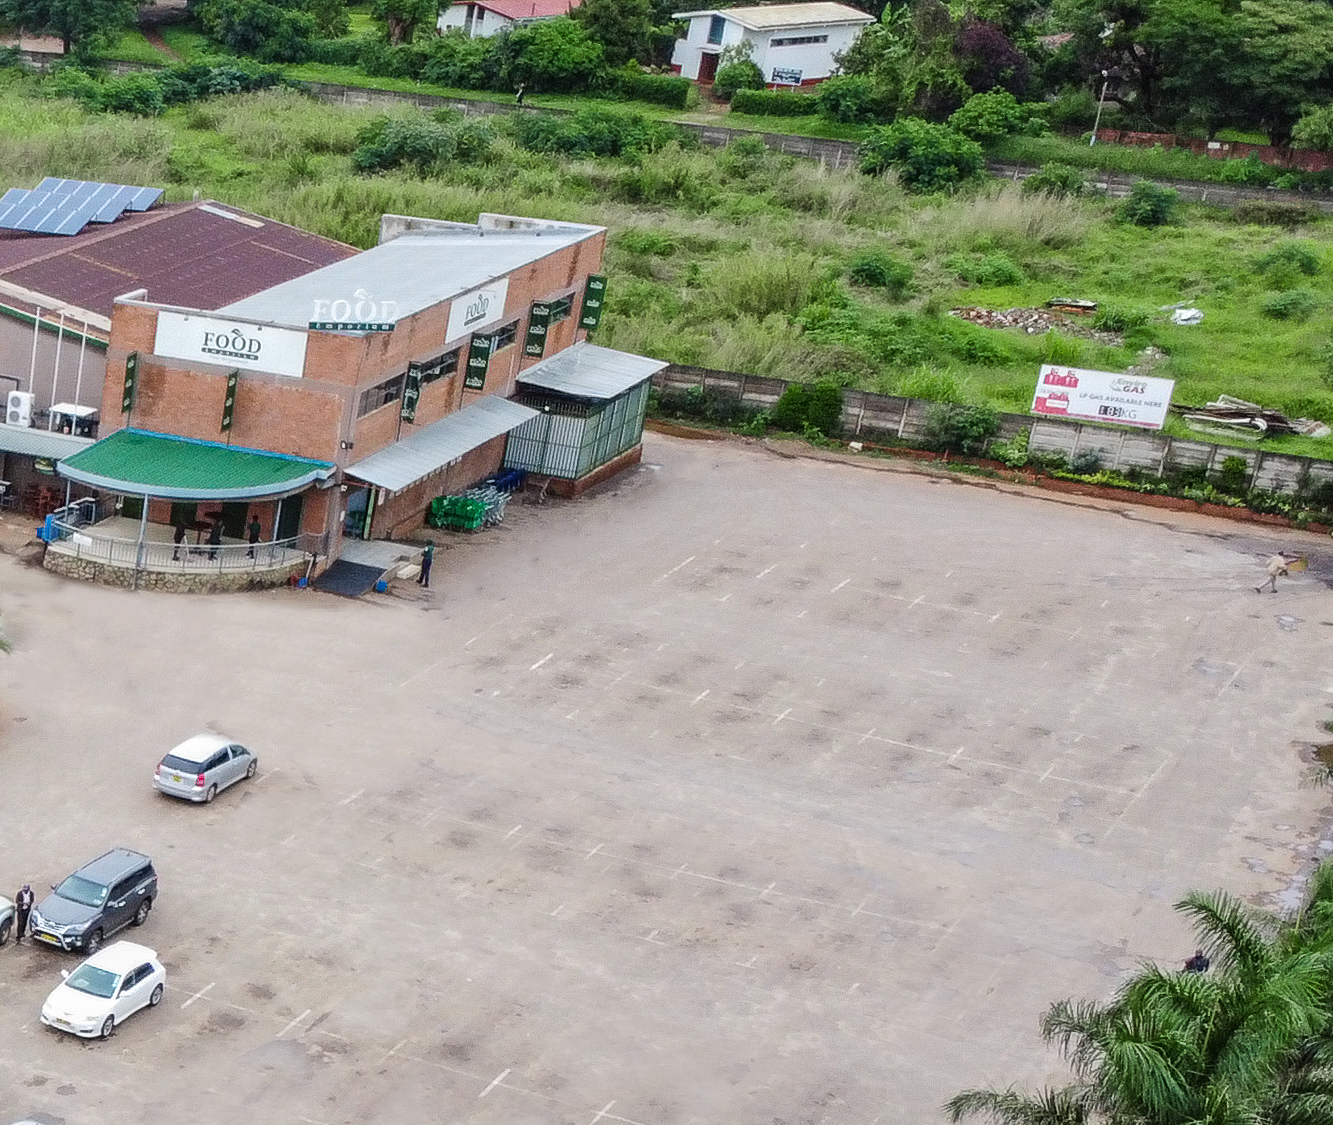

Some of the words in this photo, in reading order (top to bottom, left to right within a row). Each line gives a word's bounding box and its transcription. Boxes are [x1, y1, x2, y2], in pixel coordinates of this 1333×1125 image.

[313, 299, 398, 323] FOOD
[203, 331, 262, 354] FOOD
[1123, 386, 1145, 395] GAS
